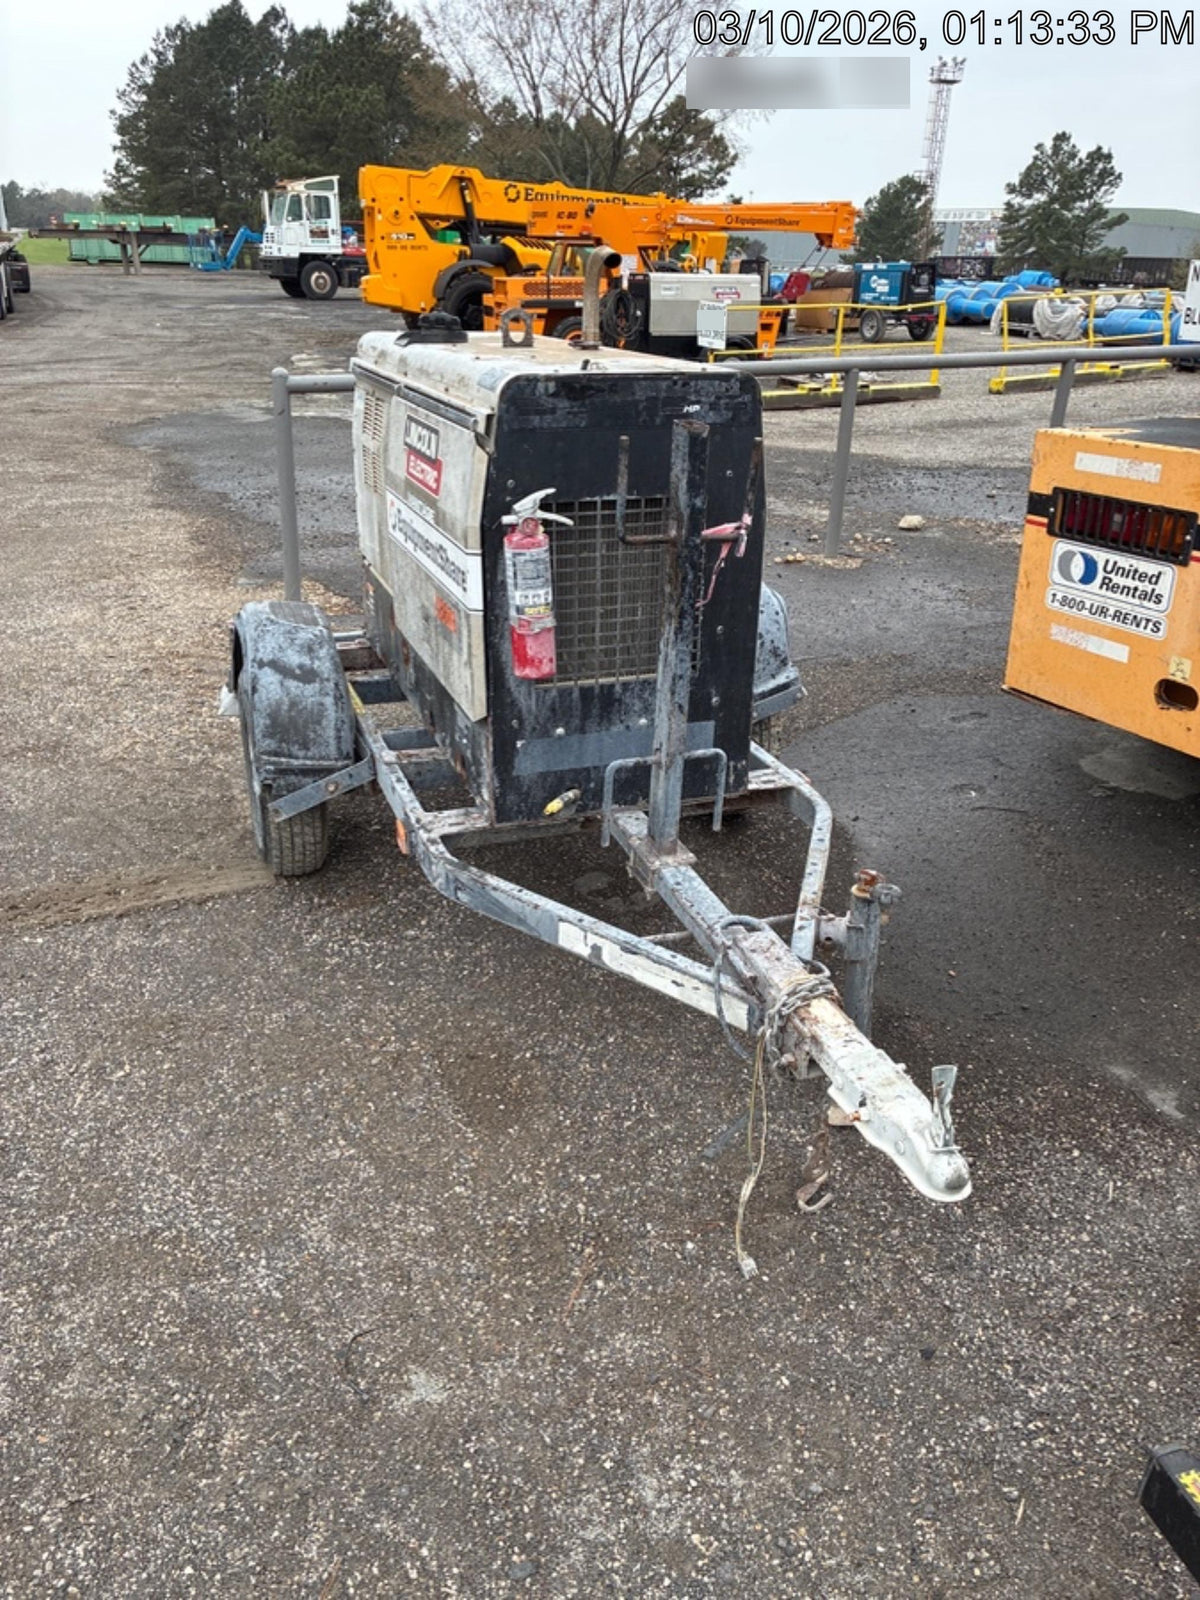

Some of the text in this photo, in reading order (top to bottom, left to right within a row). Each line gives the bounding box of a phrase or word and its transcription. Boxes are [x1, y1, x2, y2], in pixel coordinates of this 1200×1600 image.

[1102, 558, 1162, 586] United
[1098, 575, 1164, 605] Rentals
[1050, 592, 1162, 634] 1-800-UR-RENTS
